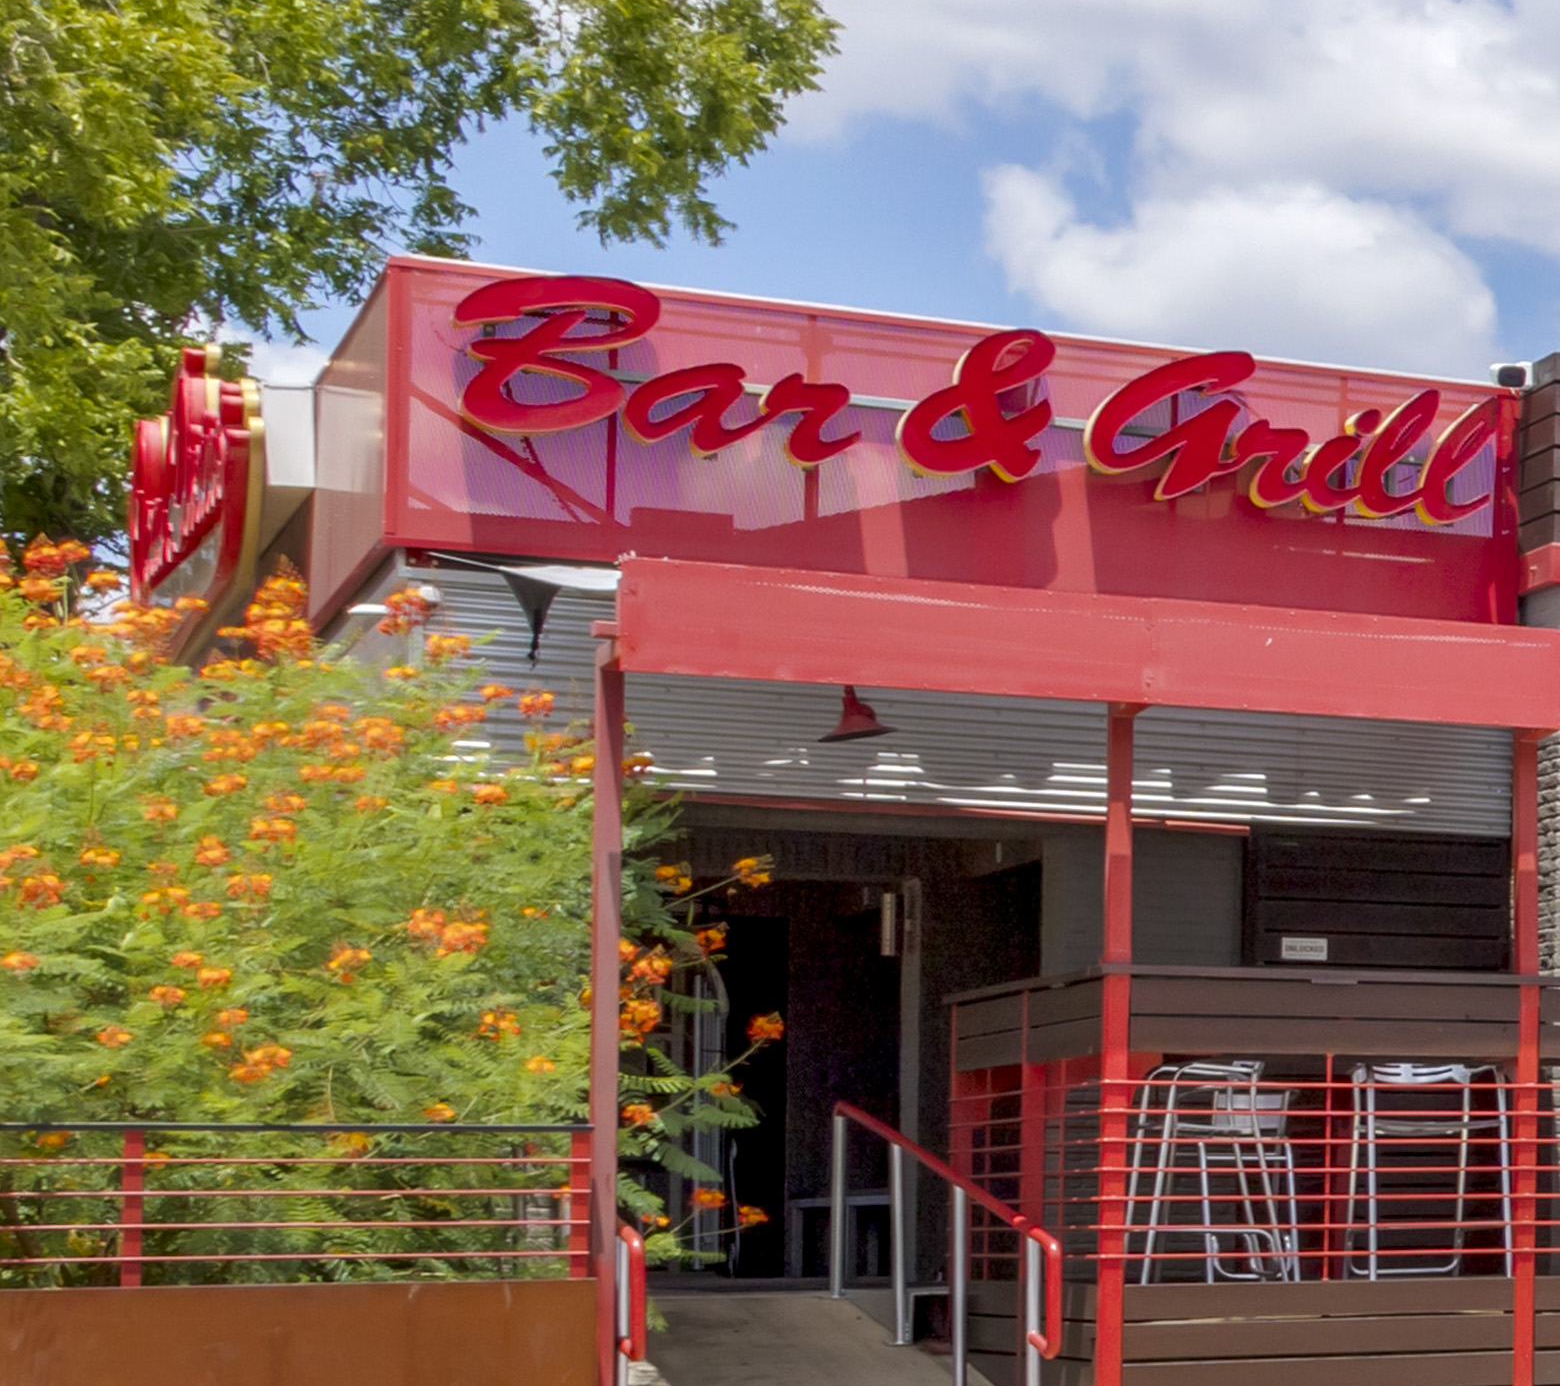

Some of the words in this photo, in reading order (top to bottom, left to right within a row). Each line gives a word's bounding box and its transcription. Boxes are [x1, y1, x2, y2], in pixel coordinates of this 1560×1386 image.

[452, 275, 863, 468] Bar
[895, 328, 1057, 483] &
[1083, 351, 1499, 526] Grill
